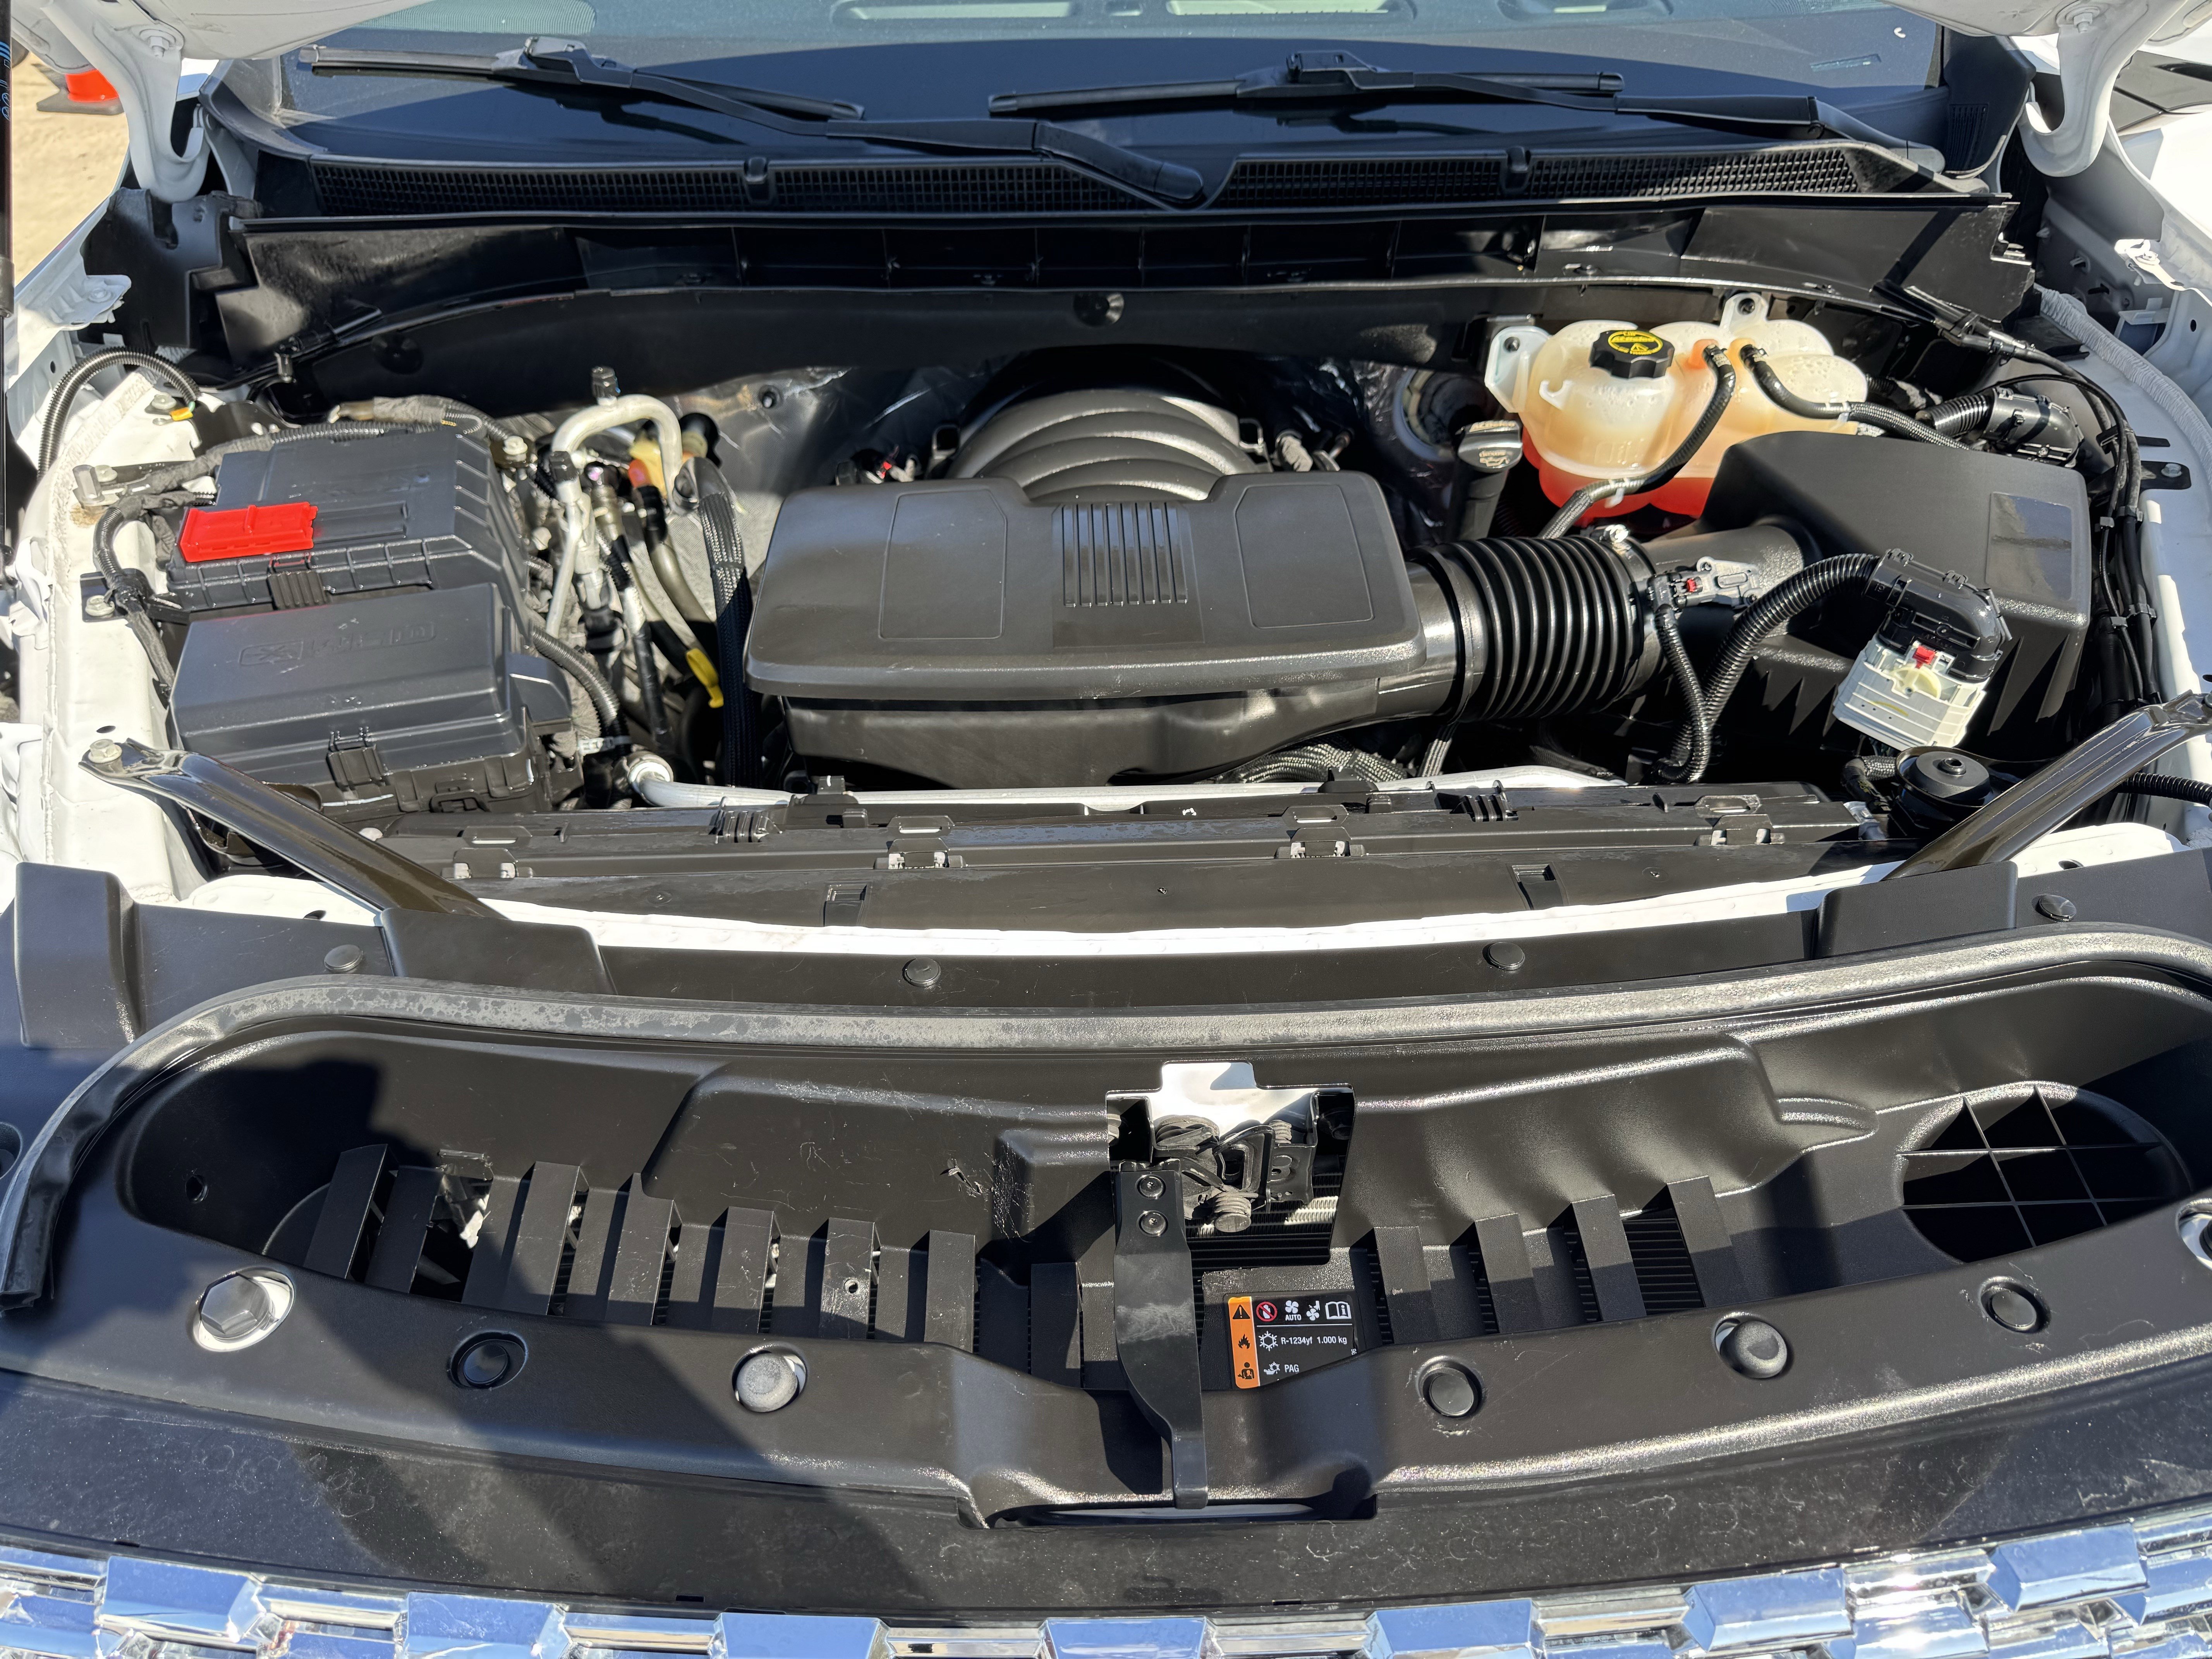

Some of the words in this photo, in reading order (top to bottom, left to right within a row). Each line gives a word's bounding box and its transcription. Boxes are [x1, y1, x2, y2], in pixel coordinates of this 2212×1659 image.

[1281, 1336, 1312, 1345] R-1234yf
[1317, 1336, 1336, 1344] 1.000
[1338, 1336, 1347, 1345] kg
[1285, 1364, 1299, 1372] PAG
